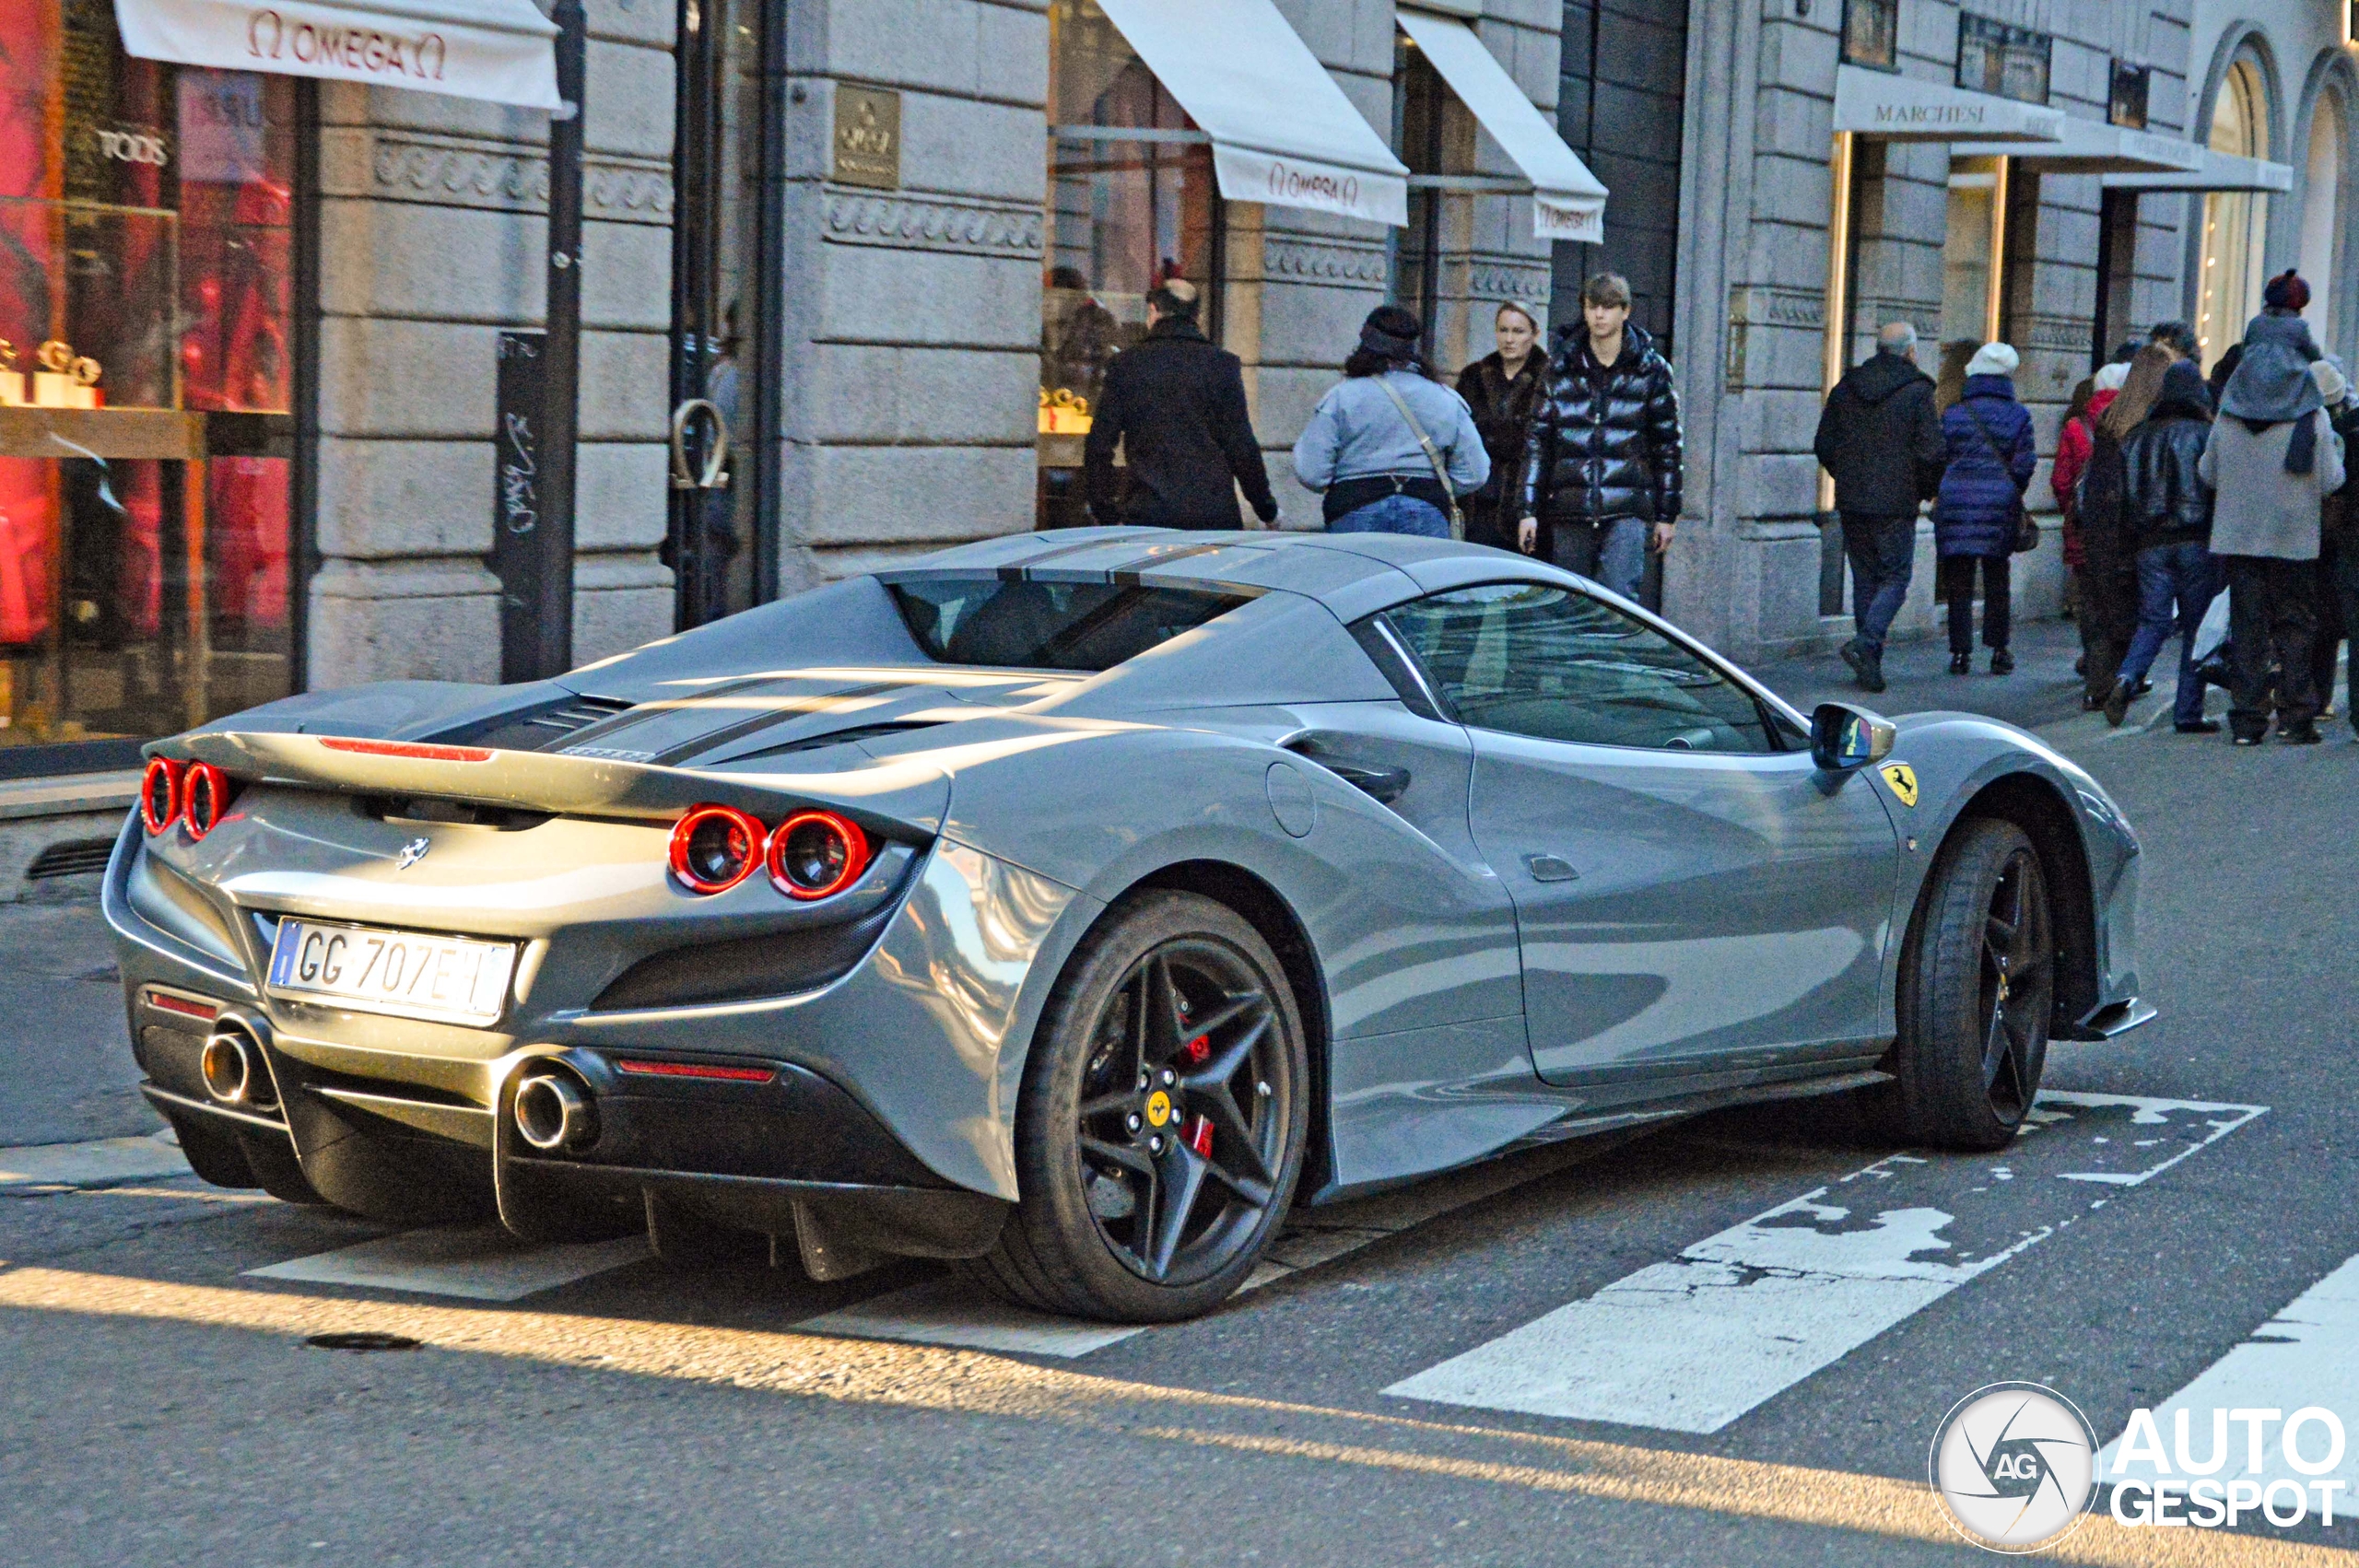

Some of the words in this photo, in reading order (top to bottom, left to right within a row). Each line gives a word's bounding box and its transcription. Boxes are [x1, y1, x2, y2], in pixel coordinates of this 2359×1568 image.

[292, 24, 406, 76] OMEGA
[1875, 103, 1986, 124] MARCHESI
[1287, 171, 1338, 200] OMEGA
[299, 930, 348, 985] GG
